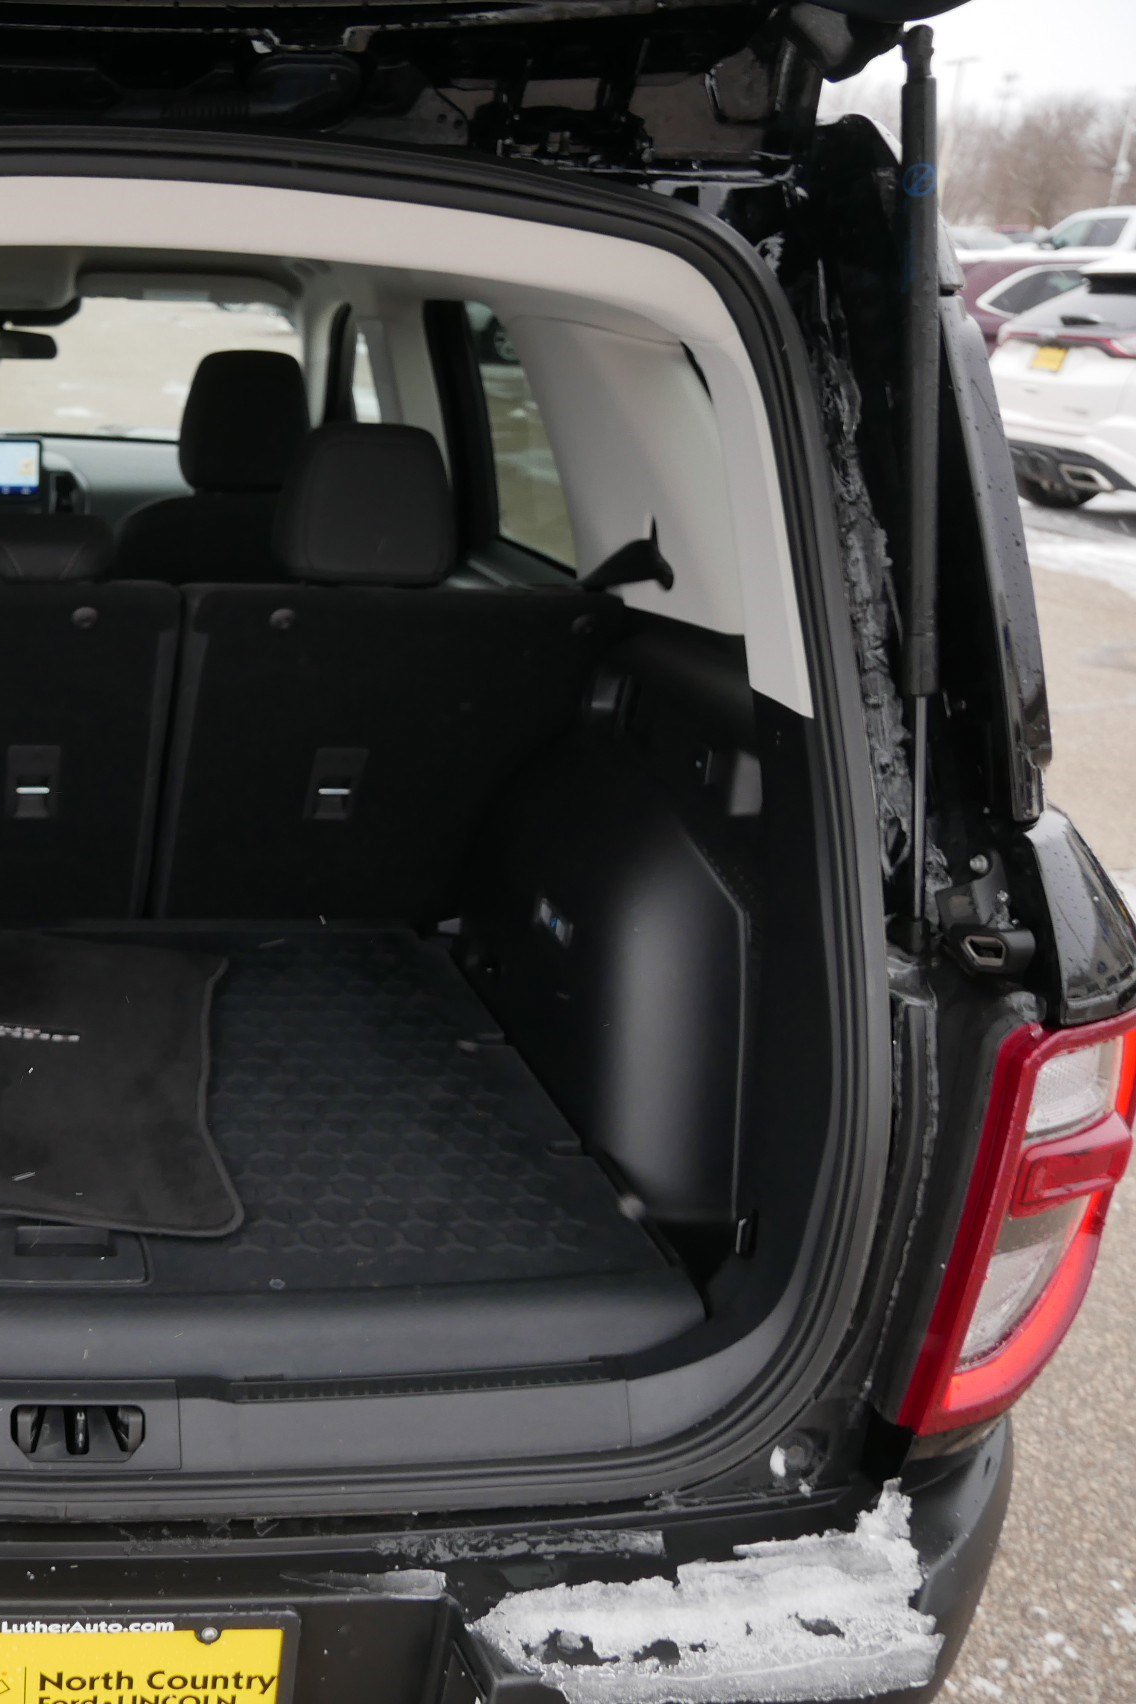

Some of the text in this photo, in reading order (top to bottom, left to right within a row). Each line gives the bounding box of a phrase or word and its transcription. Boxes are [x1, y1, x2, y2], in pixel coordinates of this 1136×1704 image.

[0, 1620, 175, 1634] LutherAuto.com
[39, 1670, 277, 1695] North Country
